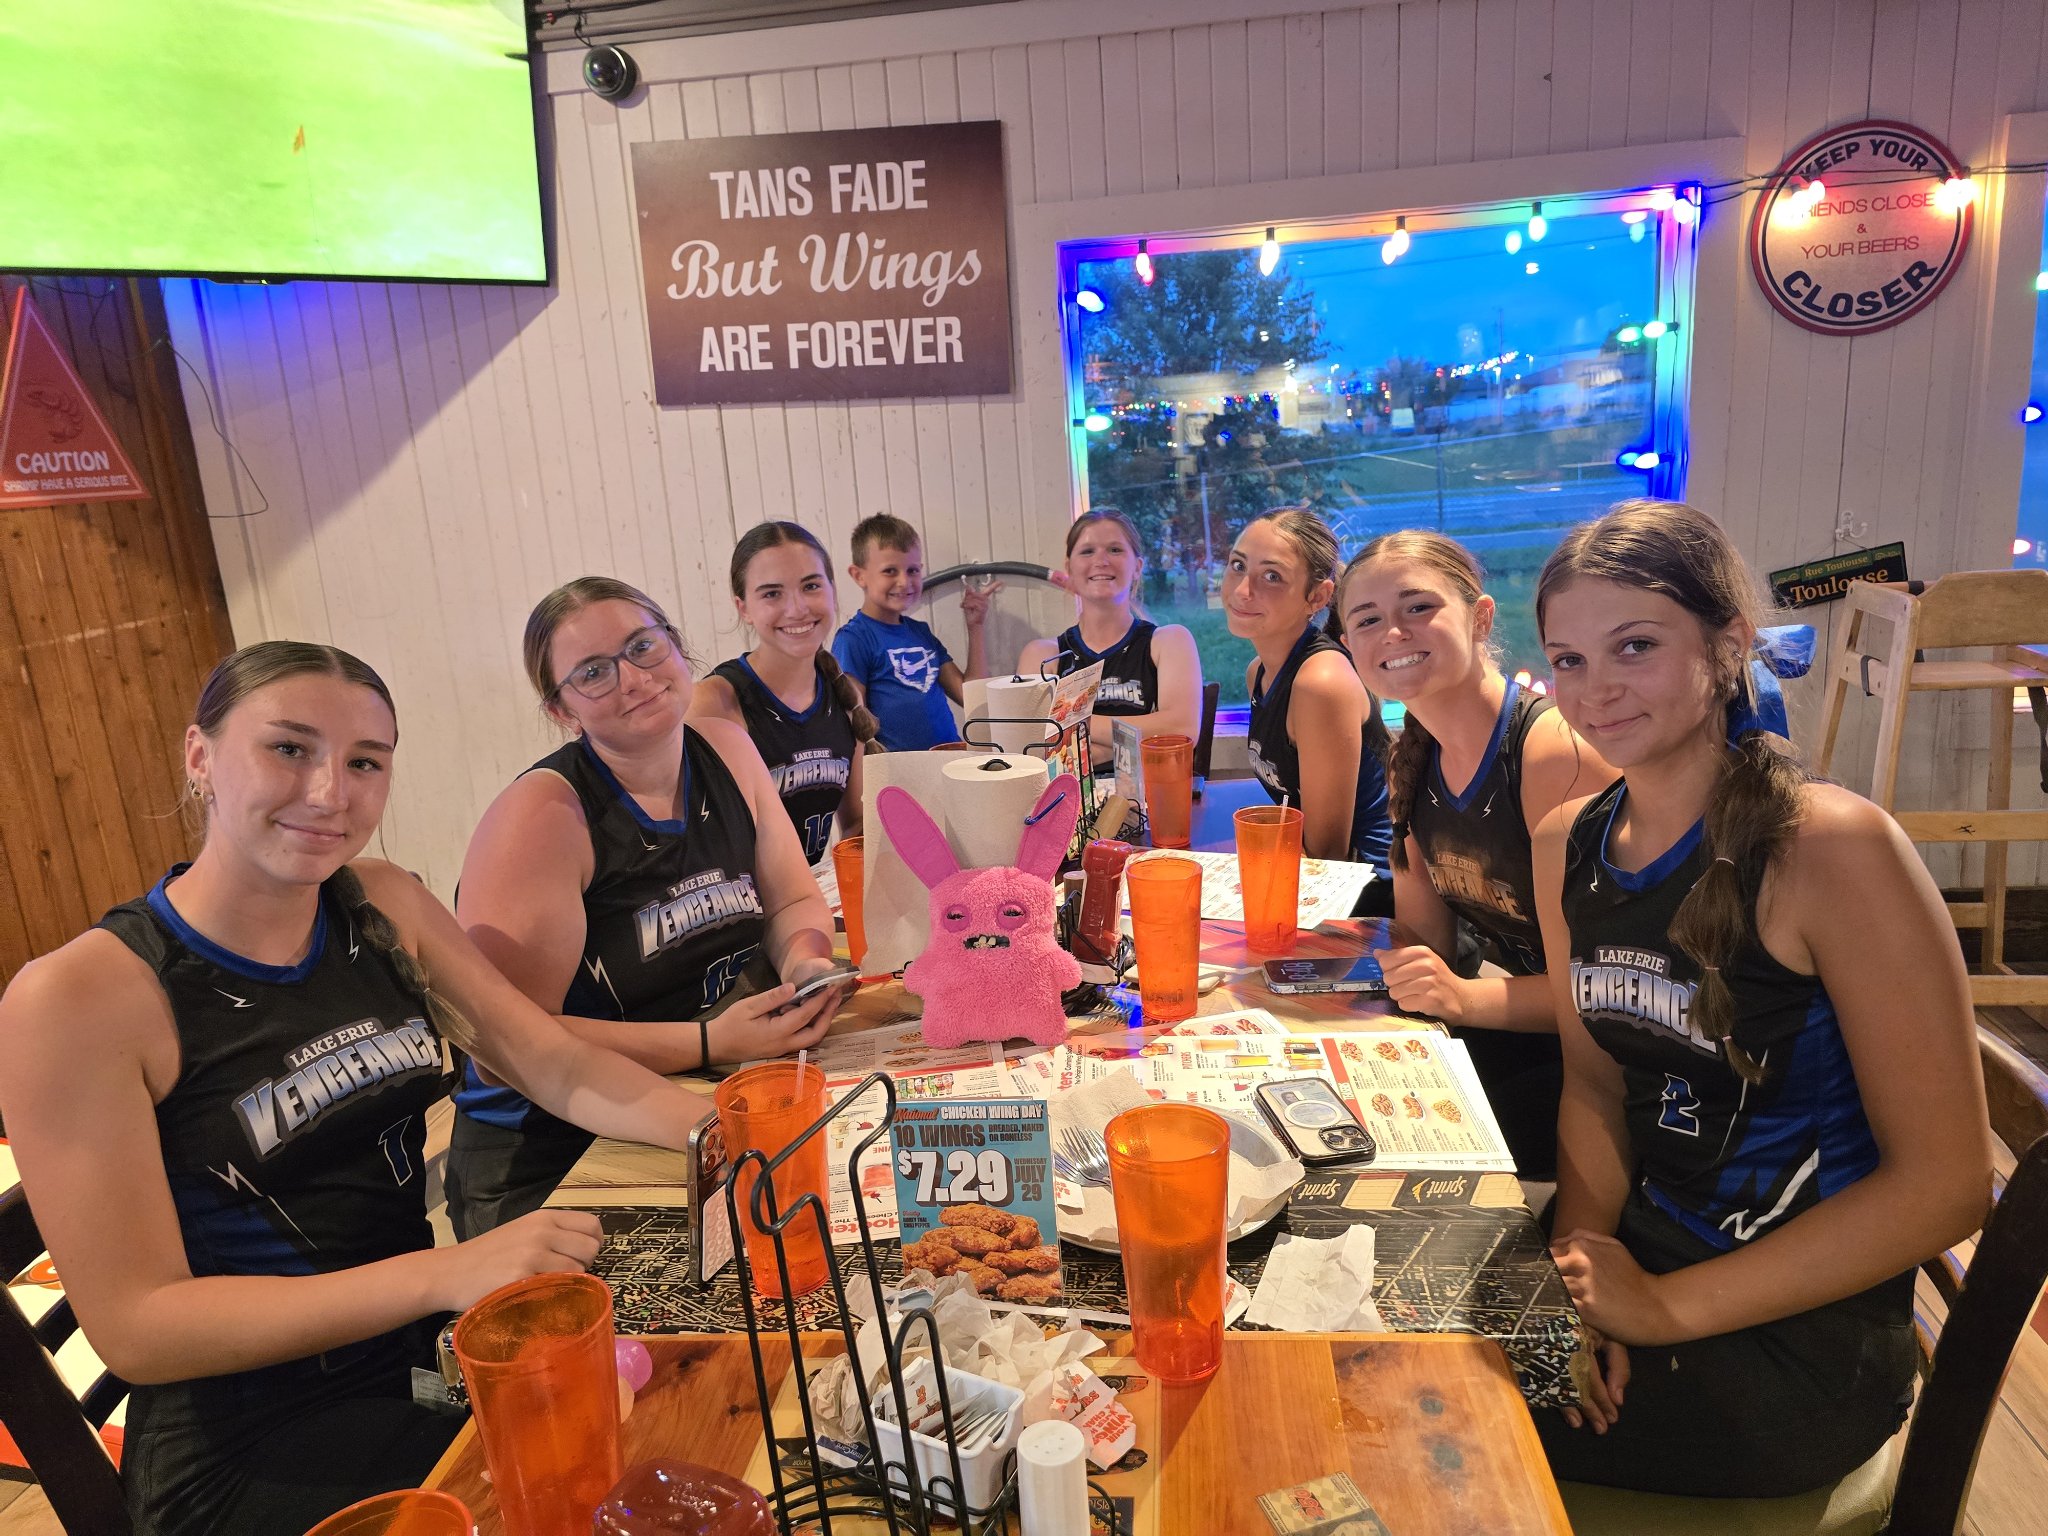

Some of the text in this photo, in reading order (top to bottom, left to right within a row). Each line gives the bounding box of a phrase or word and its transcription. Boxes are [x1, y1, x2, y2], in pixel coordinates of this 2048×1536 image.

[1869, 139, 1928, 172] YOUR
[710, 160, 928, 219] TANS FADE
[1857, 223, 1867, 234] &
[1801, 236, 1920, 260] YOUR BEERS
[667, 232, 982, 307] But Wings
[1783, 261, 1938, 317] CLOSER
[700, 316, 963, 372] ARE FOREVER
[15, 450, 110, 474] CAUTION
[66, 477, 73, 488] A
[1804, 555, 1869, 577] Rue Toulouse
[794, 750, 830, 762] LAKE ERIE
[1437, 854, 1457, 867] LAKE
[671, 872, 721, 897] LAKE ERIE
[638, 875, 763, 957] VENGEANCE
[1599, 950, 1665, 973] LAKE ERIE
[290, 1021, 377, 1067] LAKE ERIE
[239, 1018, 442, 1156] VENGEANCE
[894, 1103, 1043, 1124] National CHICKEN WING DAY
[1658, 1072, 1700, 1137] 2
[894, 1124, 985, 1147] 10 WINGS
[1000, 1133, 1032, 1141] BONELESS
[1022, 1123, 1044, 1131] NAKED
[897, 1149, 1011, 1204] $7.29
[1014, 1165, 1045, 1183] JULY
[1022, 1184, 1042, 1201] 29
[1298, 1179, 1341, 1200] Sprint
[1426, 1176, 1467, 1199] Sprint
